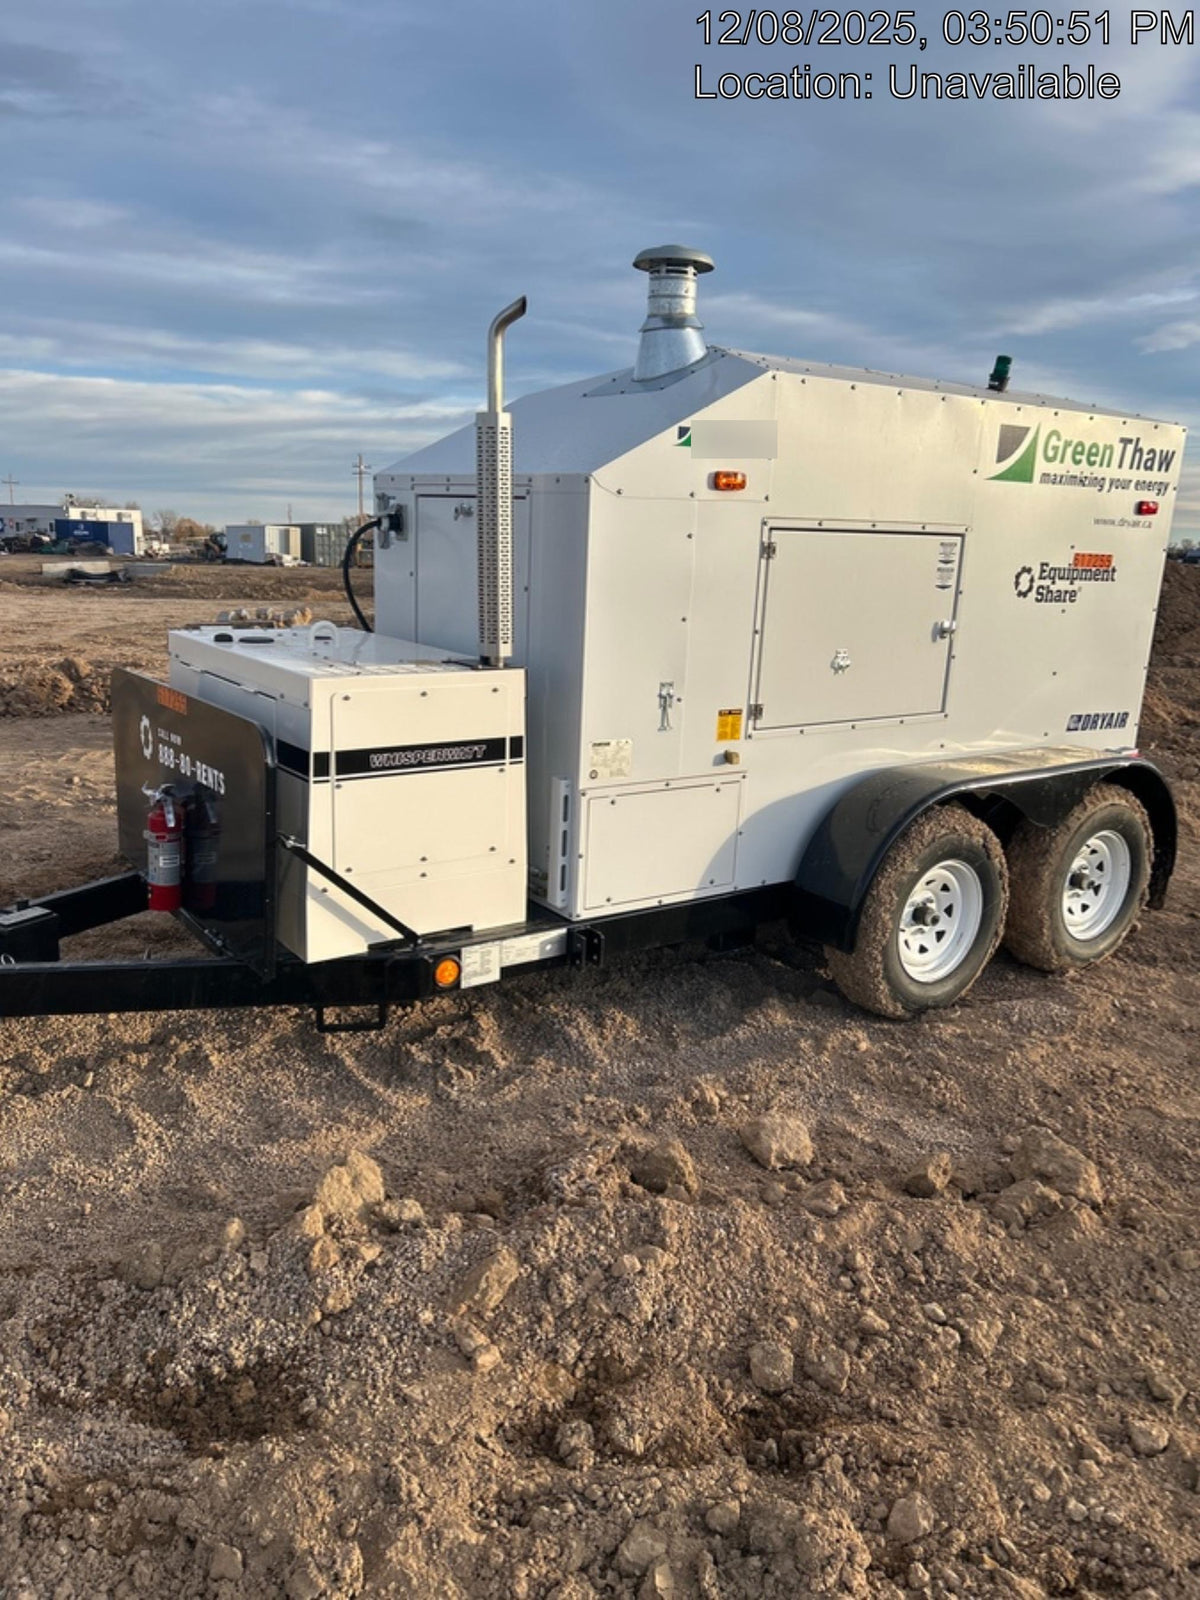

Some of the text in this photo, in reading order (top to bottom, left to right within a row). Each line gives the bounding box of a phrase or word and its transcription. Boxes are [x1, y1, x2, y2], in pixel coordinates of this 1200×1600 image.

[1039, 470, 1171, 497] maximizing your energy
[1038, 562, 1117, 585] Equipment
[369, 744, 487, 768] WHISPERWATT
